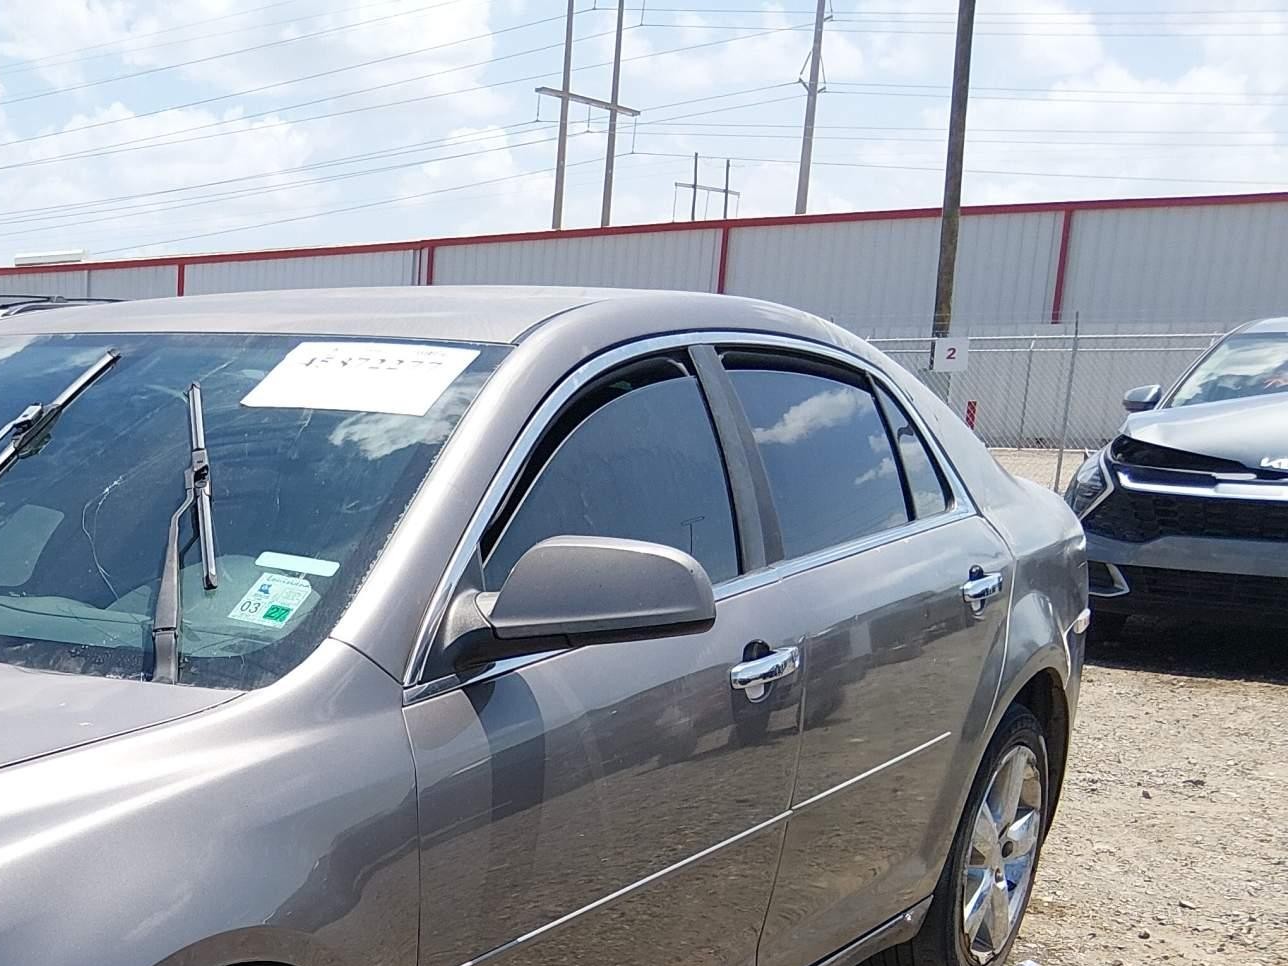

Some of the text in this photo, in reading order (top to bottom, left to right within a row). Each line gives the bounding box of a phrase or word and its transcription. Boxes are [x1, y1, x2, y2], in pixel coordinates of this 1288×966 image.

[945, 347, 956, 360] 2
[240, 601, 261, 613] 03
[266, 607, 290, 620] 27
